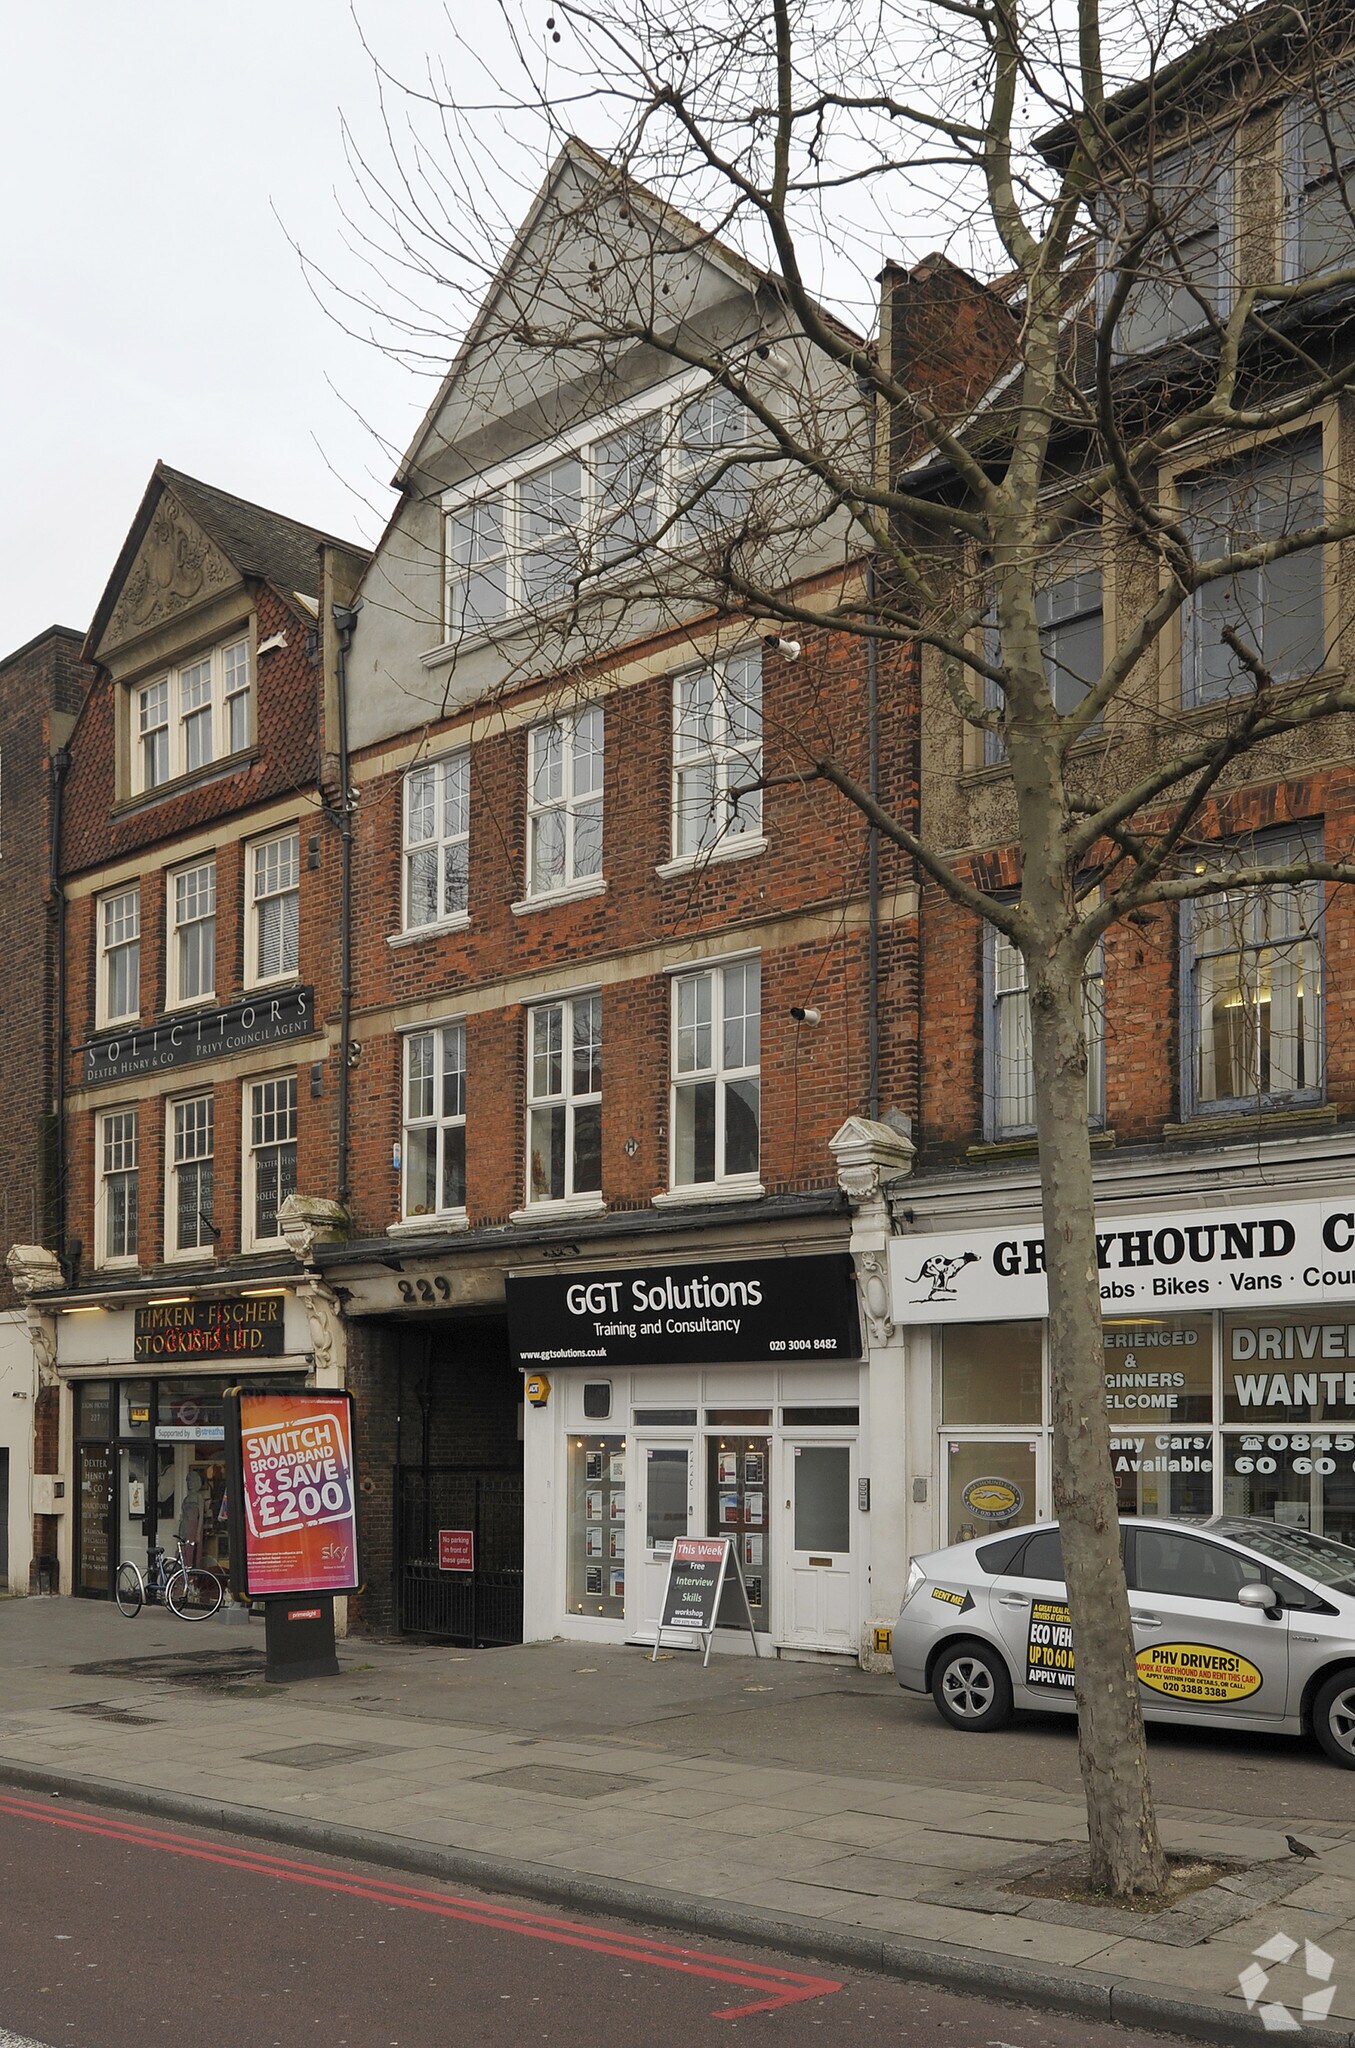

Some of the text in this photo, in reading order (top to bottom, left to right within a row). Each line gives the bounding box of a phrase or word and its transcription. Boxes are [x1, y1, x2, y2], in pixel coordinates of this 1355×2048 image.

[88, 992, 306, 1067] SOLICITORS
[196, 1020, 308, 1056] PRIVY COUNCIL AGENT
[88, 1062, 118, 1081] DEXTER
[121, 1058, 149, 1073] HENRY
[152, 1056, 158, 1065] &
[282, 1156, 297, 1165] HEN
[993, 1219, 1296, 1276] GRYHOUND
[398, 1276, 451, 1303] 229
[1100, 1280, 1135, 1299] abs
[1152, 1276, 1209, 1296] Bikes
[1230, 1271, 1282, 1291] Vans
[566, 1275, 763, 1315] GGT Solutions
[139, 1306, 195, 1328] TIMKEN
[208, 1301, 278, 1325] FISCHER
[593, 1316, 741, 1338] Training and Consultancy
[135, 1331, 221, 1355] STOCKISTS
[769, 1338, 838, 1351] 020 3004 8482
[1103, 1330, 1199, 1349] ERIENCED
[520, 1347, 607, 1361] www.ggtsolutions.co.uk
[1124, 1352, 1137, 1368] &
[1104, 1371, 1186, 1388] GINNERS
[1105, 1393, 1179, 1409] ELCOME
[159, 1429, 184, 1438] Supported
[184, 1429, 191, 1439] by
[246, 1424, 331, 1459] SWITCH
[1267, 1434, 1355, 1452] 0845
[1109, 1437, 1146, 1453] any
[250, 1446, 334, 1473] BROADBAND
[1115, 1456, 1213, 1473] Available
[1234, 1456, 1277, 1474] 60
[1292, 1457, 1336, 1475] 60
[254, 1459, 339, 1495] & SAVE
[259, 1481, 344, 1526] £200
[450, 1536, 469, 1545] parking
[321, 1542, 349, 1563] sky
[678, 1544, 696, 1554] This
[698, 1545, 723, 1556] Week
[457, 1557, 470, 1565] gates
[690, 1562, 705, 1570] Free
[676, 1576, 714, 1587] Interview
[682, 1592, 702, 1602] Skills
[932, 1588, 951, 1602] RENT
[292, 1610, 317, 1619] primesight
[675, 1608, 704, 1618] workshop
[1030, 1623, 1073, 1648] ECO VEH
[1029, 1645, 1041, 1663] UP
[1042, 1647, 1054, 1666] TO
[1055, 1649, 1067, 1668] 60
[1152, 1649, 1240, 1672] PHV DRIVERS!
[1028, 1668, 1056, 1684] APPLY
[1136, 1663, 1155, 1672] WORK
[1155, 1665, 1162, 1673] AT
[1163, 1666, 1198, 1677] GREYHOUND
[1199, 1669, 1211, 1679] AND
[1212, 1671, 1227, 1681] RENT
[1227, 1673, 1240, 1682] THIS
[1163, 1674, 1183, 1682] WITHIN
[1162, 1682, 1227, 1697] 020 3388 3388
